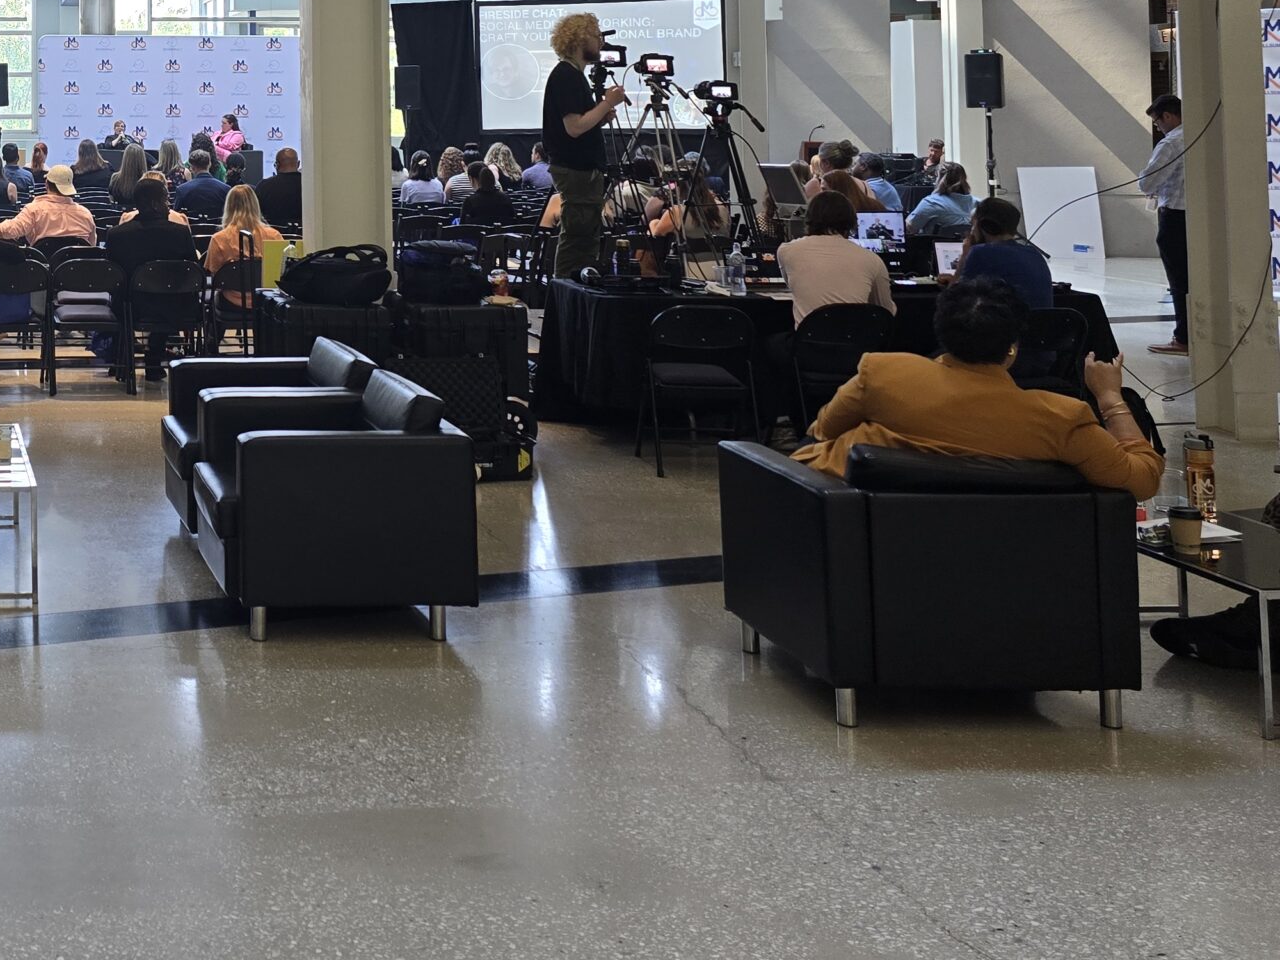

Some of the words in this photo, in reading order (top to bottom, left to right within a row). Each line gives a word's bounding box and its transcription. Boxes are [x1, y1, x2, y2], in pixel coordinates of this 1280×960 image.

[480, 9, 530, 20] FIRESIDE
[480, 21, 522, 31] SOCIAL
[525, 20, 554, 30] MEDI
[480, 32, 518, 43] CRAFT
[657, 28, 702, 39] BRAND
